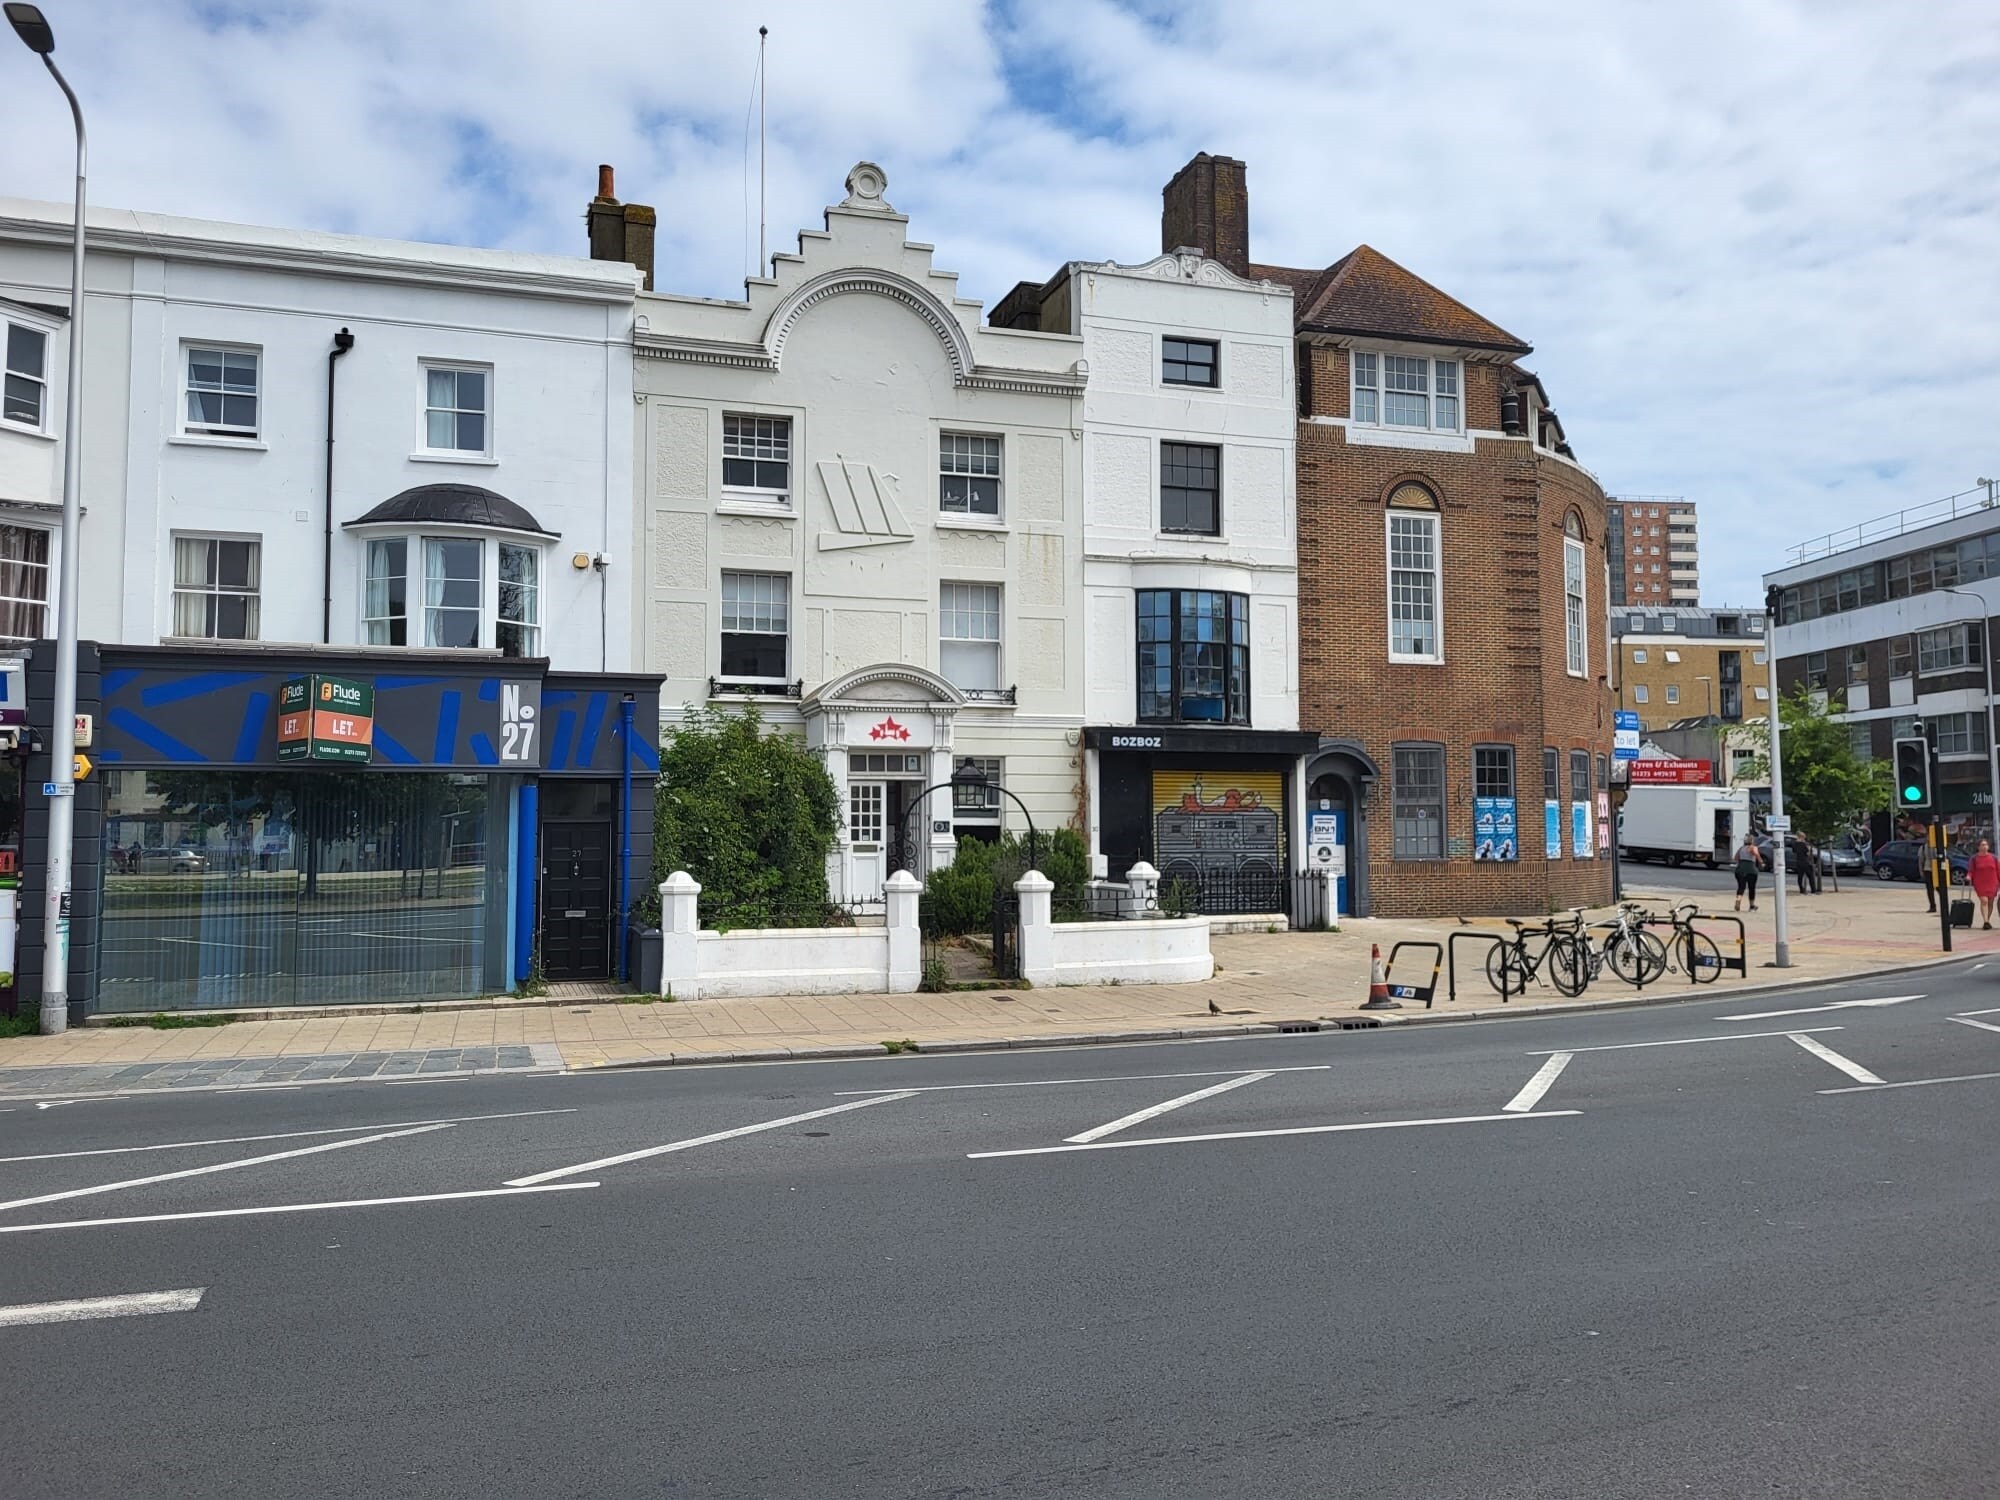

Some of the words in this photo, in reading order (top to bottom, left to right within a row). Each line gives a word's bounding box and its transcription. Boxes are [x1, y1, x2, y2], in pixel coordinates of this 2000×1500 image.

[287, 684, 304, 699] Flude
[333, 684, 361, 701] Flude
[284, 719, 296, 735] LET
[332, 719, 353, 736] LET
[502, 722, 535, 760] 27
[1112, 737, 1162, 747] BOZBOZ
[1616, 735, 1625, 745] to
[1626, 735, 1636, 746] let
[1631, 761, 1654, 769] Tyres
[1972, 792, 1983, 805] 24
[1983, 792, 1993, 804] ho
[571, 849, 582, 857] 27
[1395, 986, 1402, 996] P
